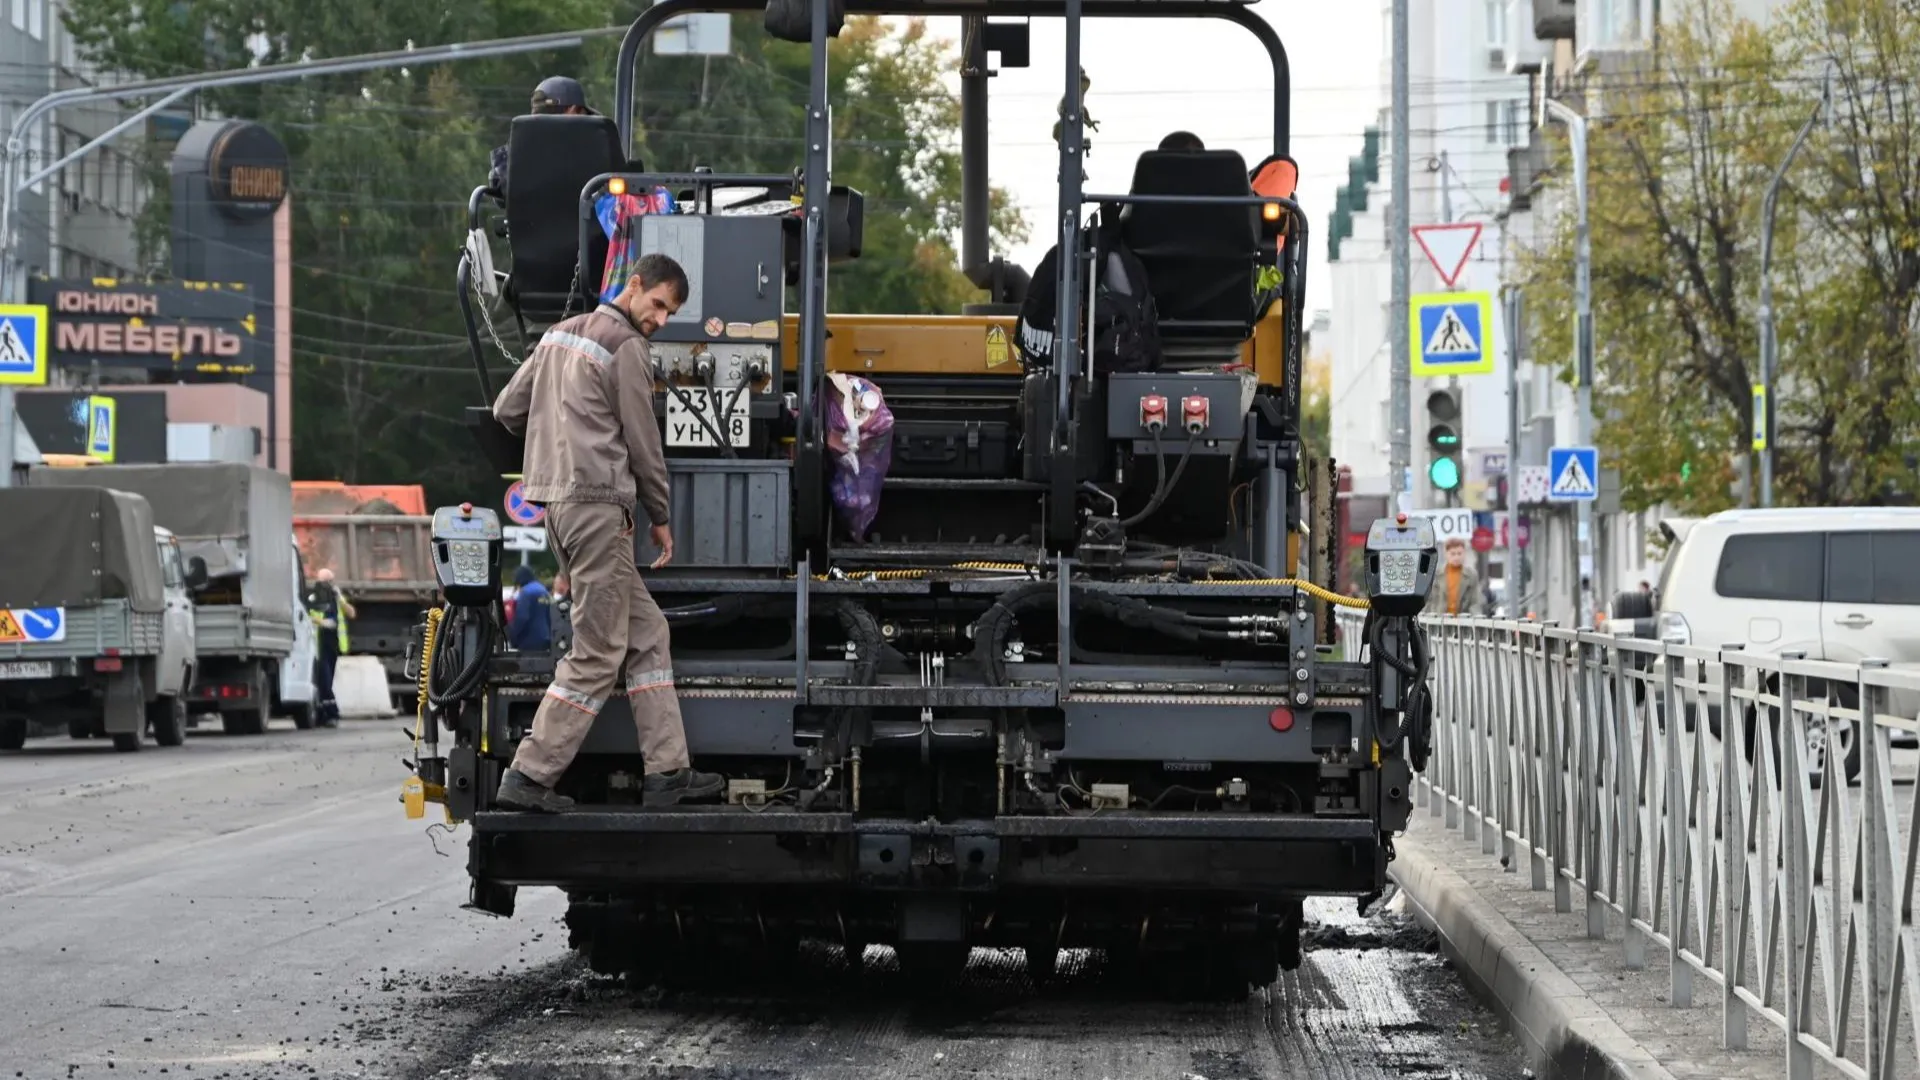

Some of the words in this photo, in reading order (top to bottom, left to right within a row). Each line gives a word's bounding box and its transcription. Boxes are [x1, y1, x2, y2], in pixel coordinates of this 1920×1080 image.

[231, 166, 282, 198] ЮНИОН
[57, 291, 158, 315] ЮНИОН
[57, 321, 241, 356] МЕБЕЛЬ
[673, 422, 703, 442] УН
